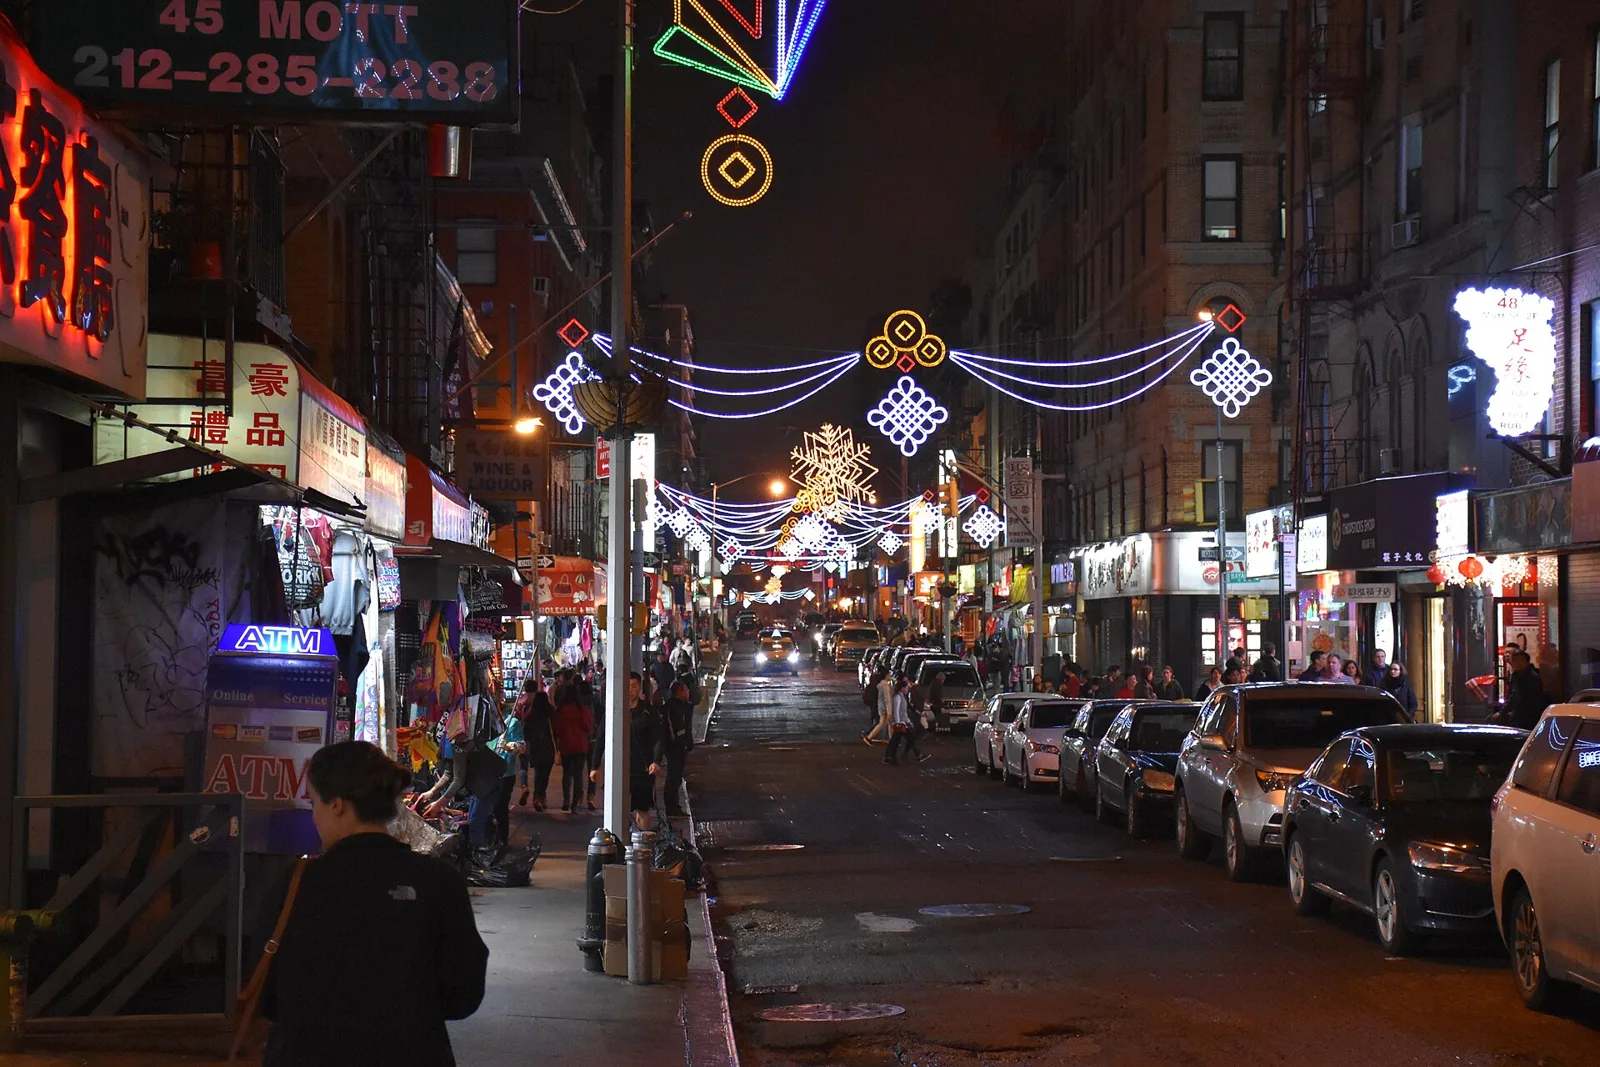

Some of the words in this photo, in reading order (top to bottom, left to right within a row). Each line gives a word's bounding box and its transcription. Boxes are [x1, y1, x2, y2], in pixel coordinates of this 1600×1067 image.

[159, 0, 224, 34] 45
[258, 0, 419, 44] MOTT
[72, 45, 499, 102] 212-285-2288
[1497, 297, 1518, 309] 48
[189, 410, 285, 447] 禮品
[473, 462, 516, 475] WINE
[522, 463, 532, 475] &
[468, 478, 534, 492] LIQUOR
[235, 625, 321, 654] ATM
[213, 690, 255, 702] Online
[283, 692, 329, 705] Service
[244, 729, 262, 737] VISA
[202, 753, 312, 800] ATM
